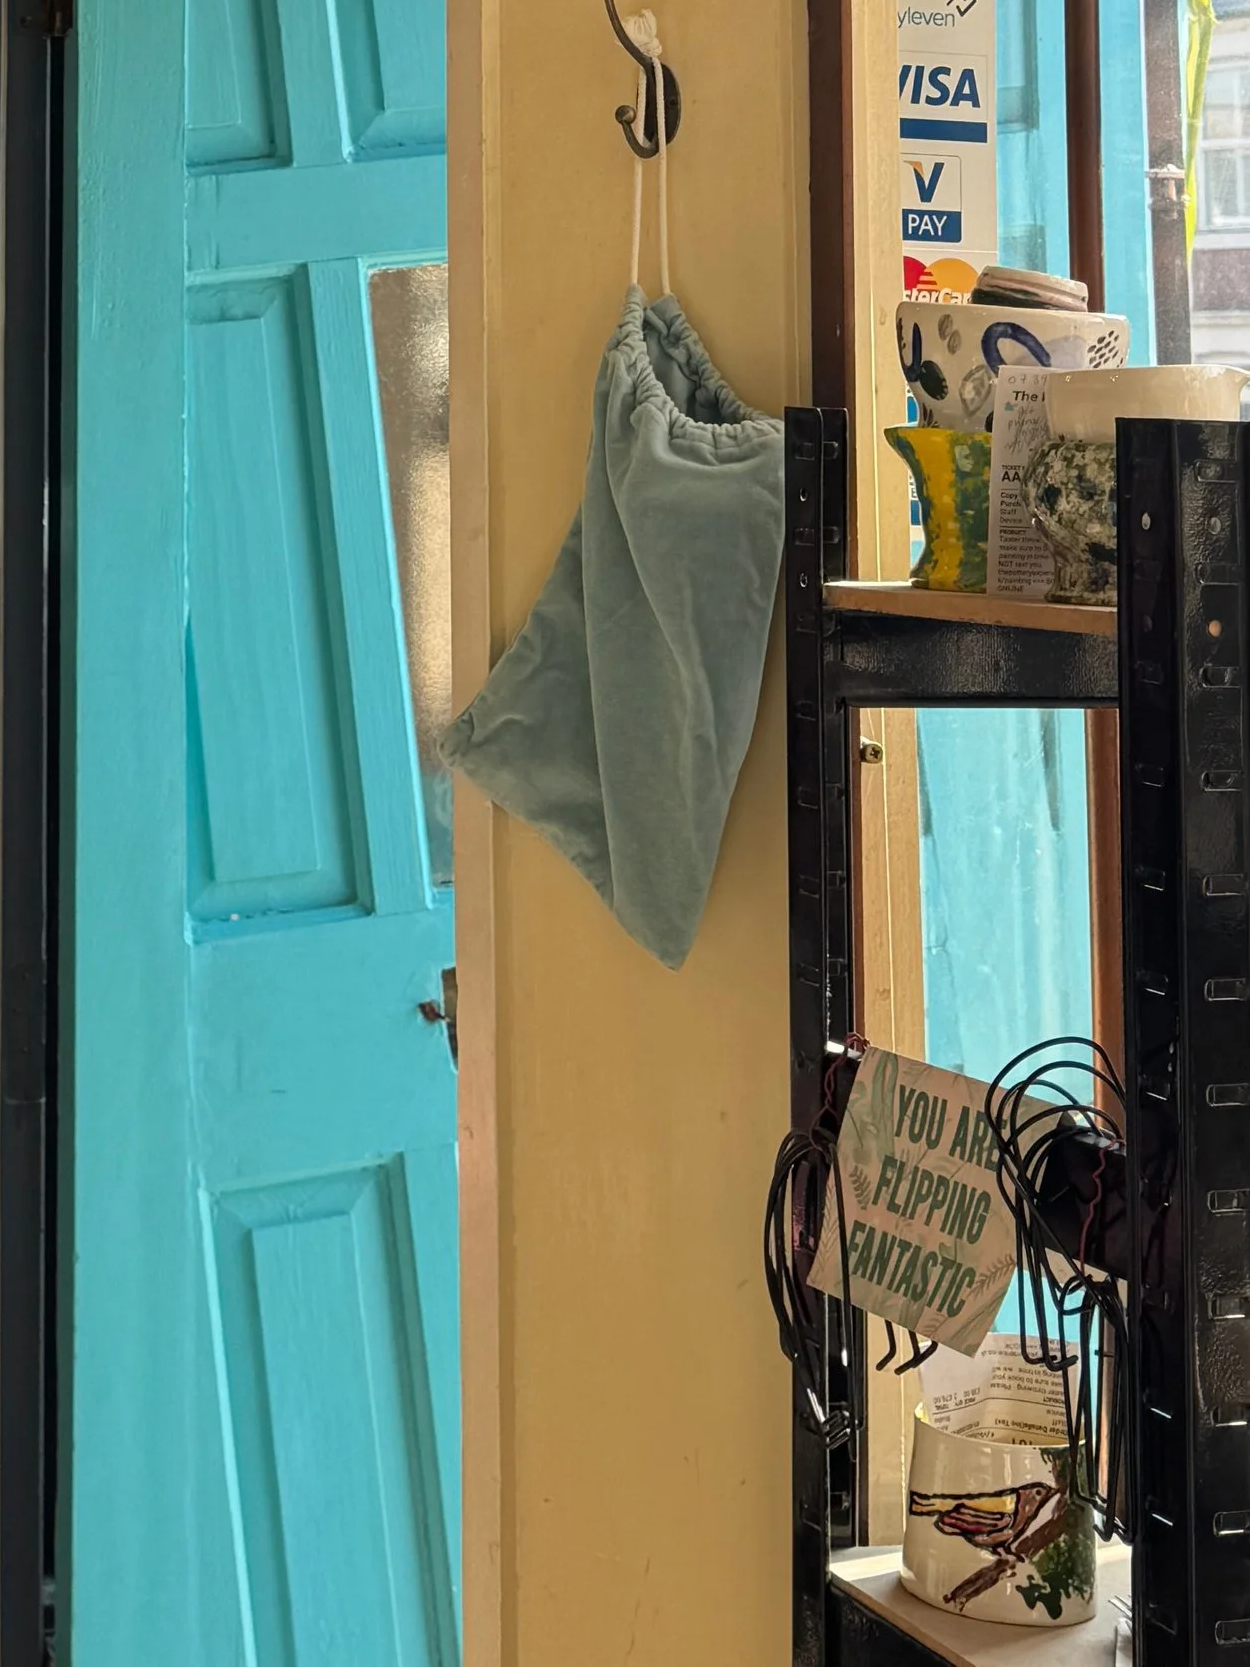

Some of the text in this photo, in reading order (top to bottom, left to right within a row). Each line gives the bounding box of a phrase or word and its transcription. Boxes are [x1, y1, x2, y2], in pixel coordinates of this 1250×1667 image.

[908, 213, 948, 236] PAY
[1012, 390, 1038, 403] The
[895, 1085, 948, 1150] YOU
[872, 1154, 991, 1245] FLIPPING
[849, 1219, 976, 1318] FANTASTIC
